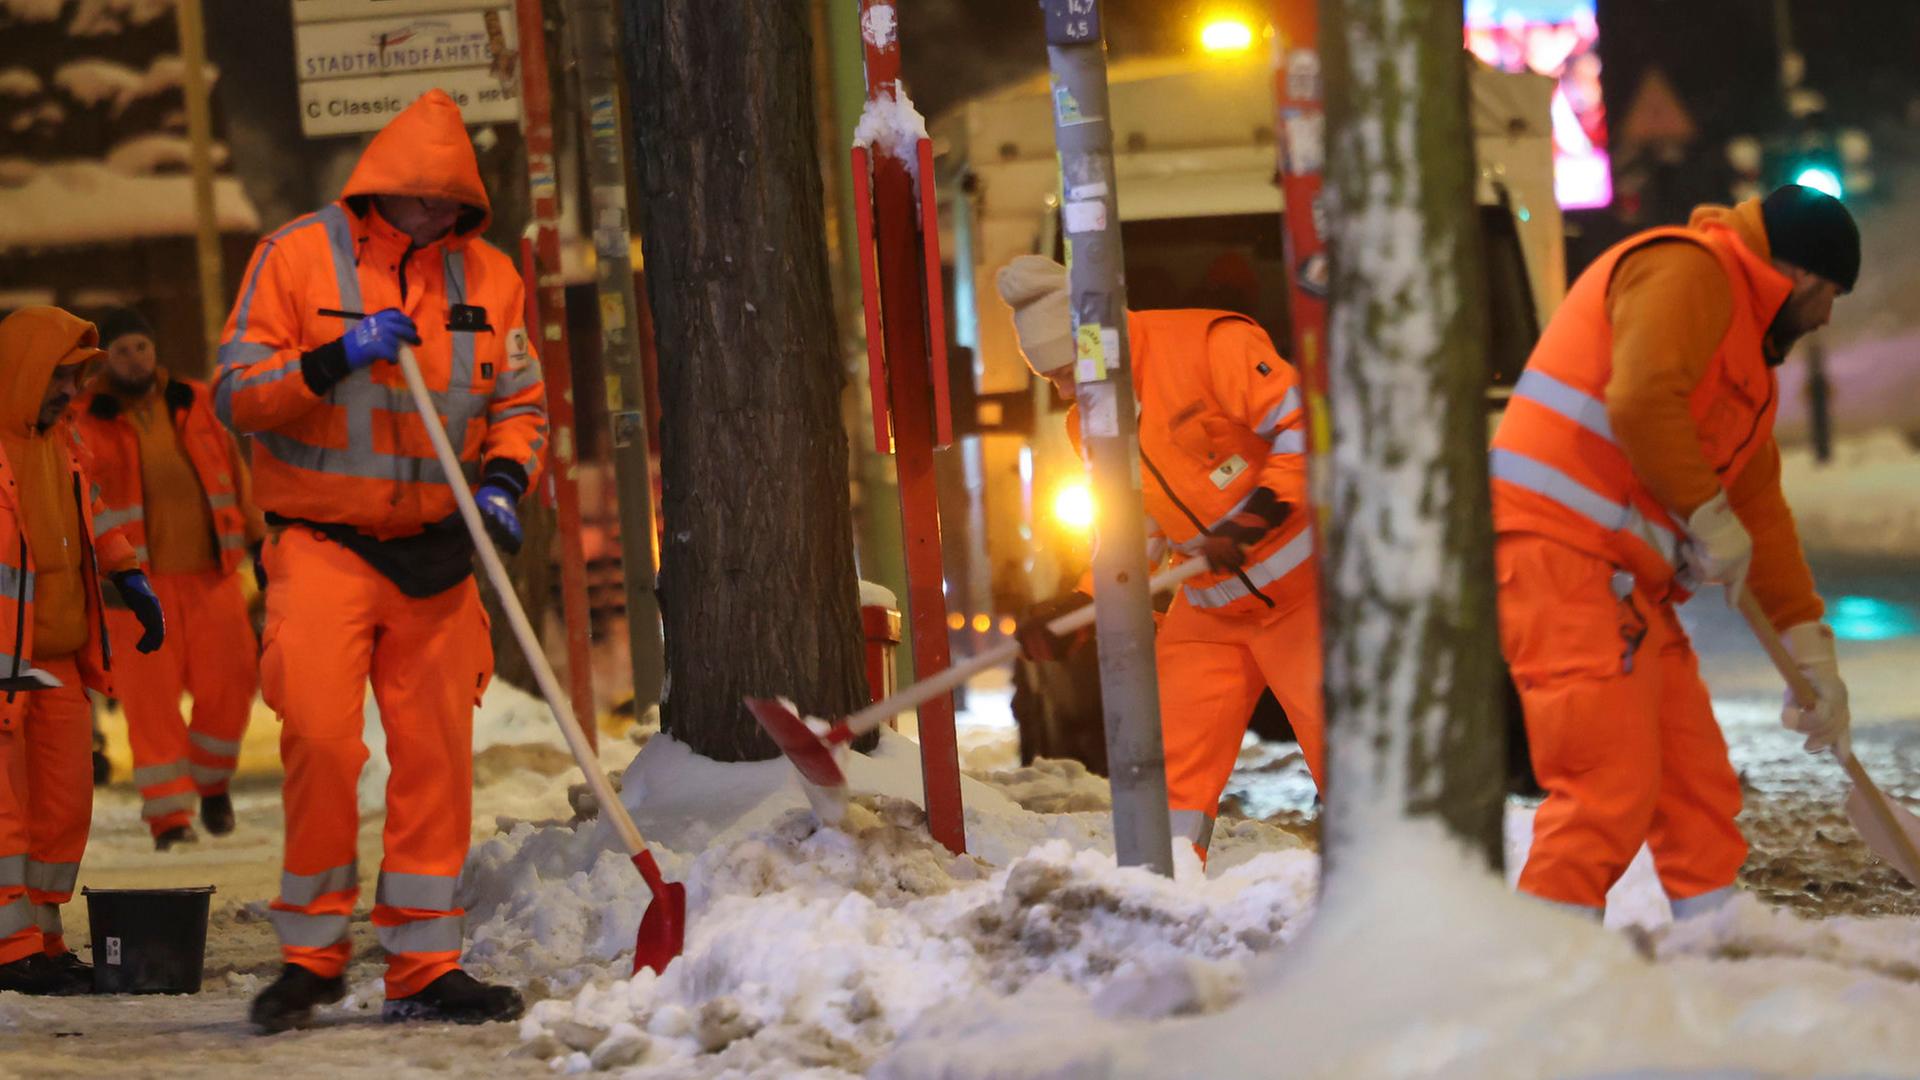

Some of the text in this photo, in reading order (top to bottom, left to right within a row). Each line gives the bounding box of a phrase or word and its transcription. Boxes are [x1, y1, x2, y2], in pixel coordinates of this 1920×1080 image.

[1066, 22, 1089, 39] 4,5
[306, 101, 321, 119] C
[328, 97, 402, 118] Classic
